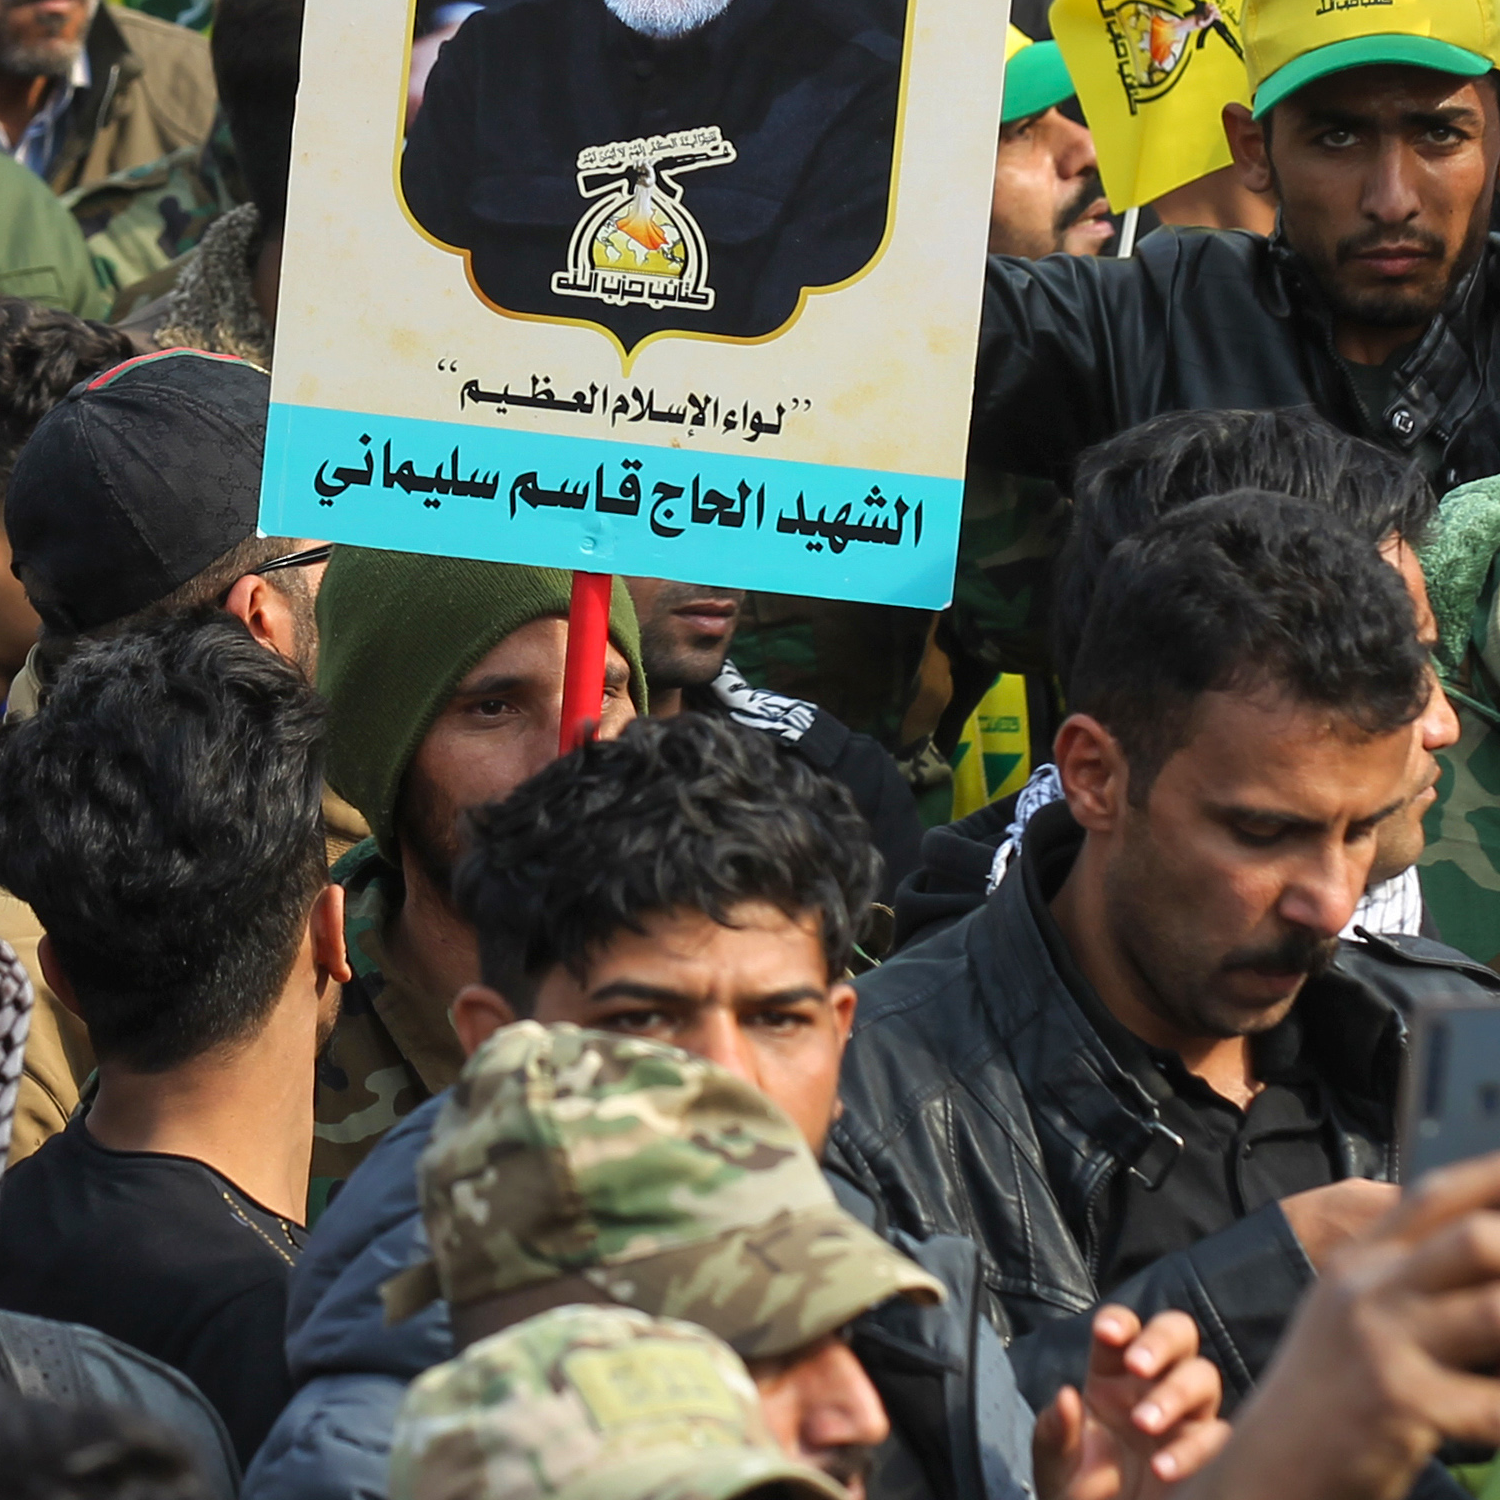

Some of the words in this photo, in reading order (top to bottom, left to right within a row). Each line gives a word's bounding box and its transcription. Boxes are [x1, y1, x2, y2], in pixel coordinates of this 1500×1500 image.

[600, 275, 644, 301] حزب
[313, 431, 501, 510] سليماني
[508, 458, 644, 521] قاسم
[648, 477, 766, 538] الحاج
[777, 484, 925, 555] الشهيد
